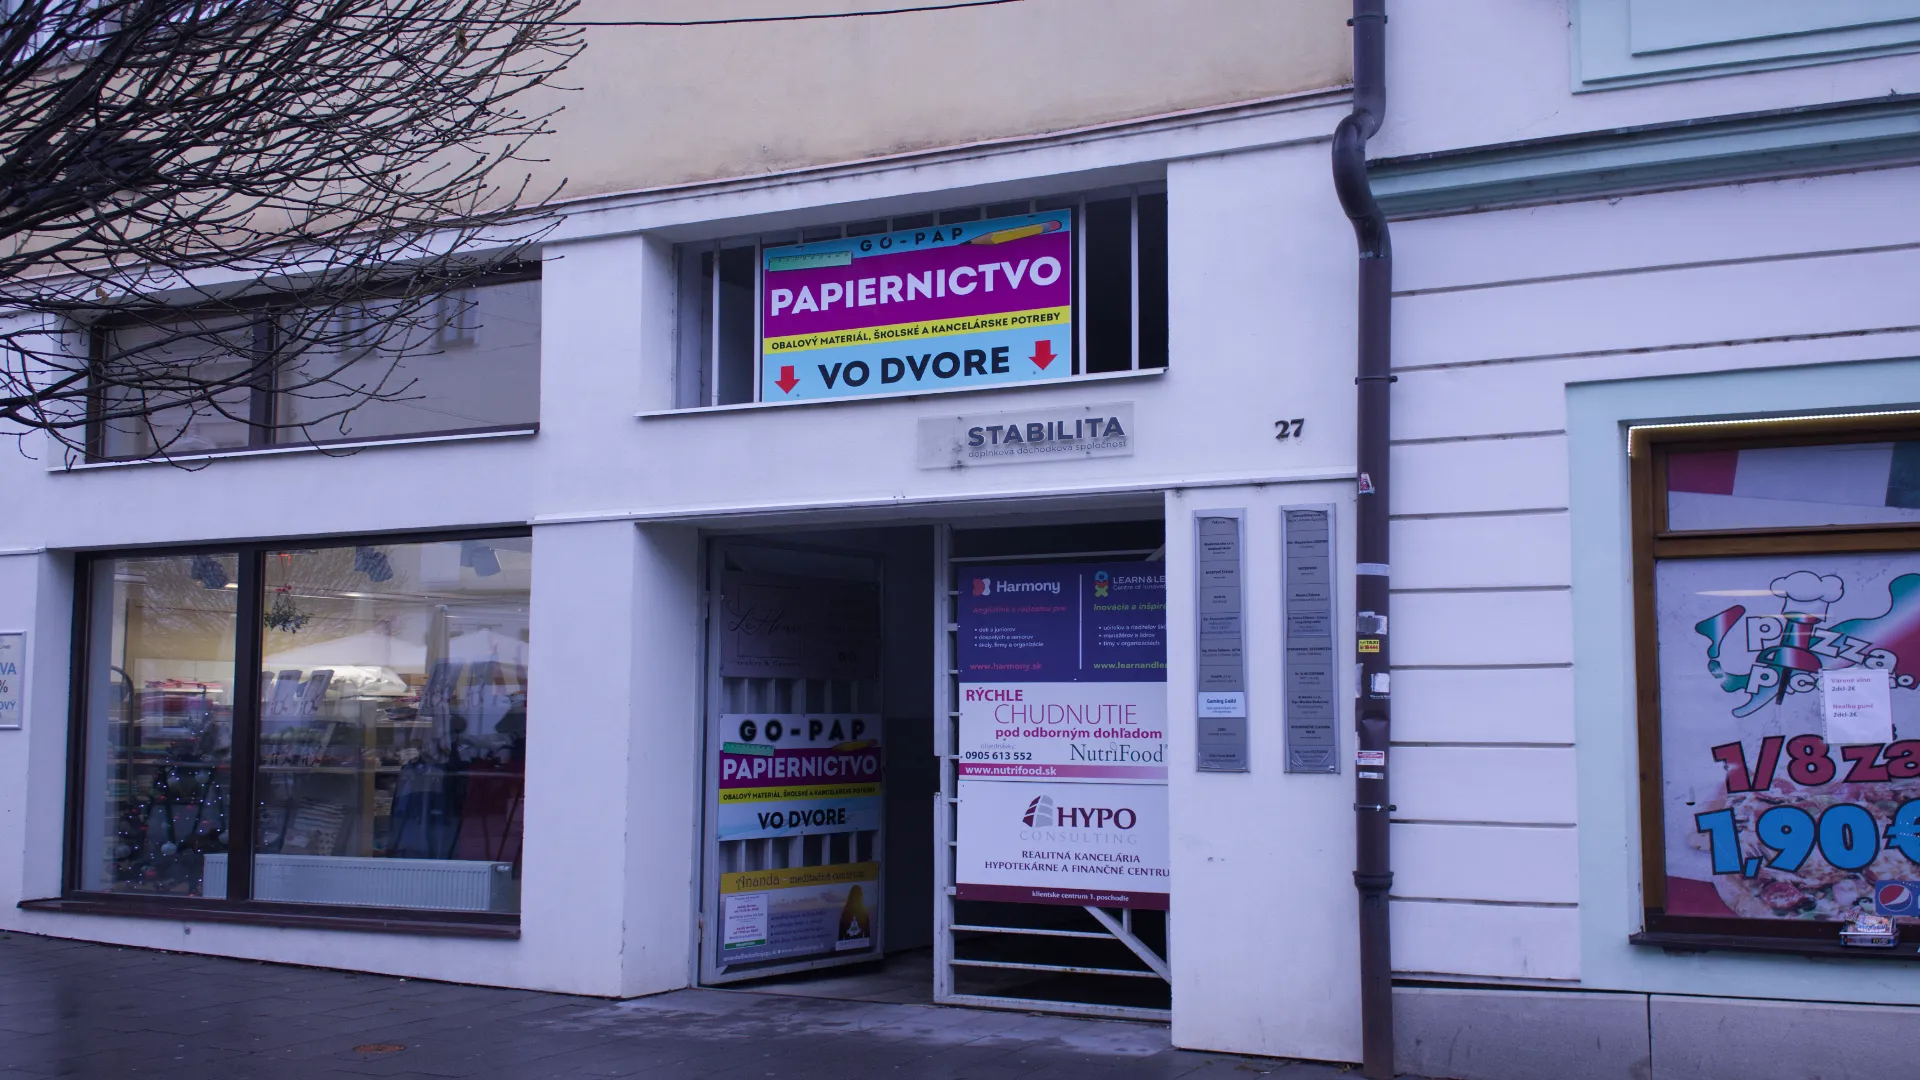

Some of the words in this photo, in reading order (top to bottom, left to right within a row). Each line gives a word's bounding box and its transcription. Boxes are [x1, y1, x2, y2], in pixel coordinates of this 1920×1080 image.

[860, 228, 965, 252] GO-PAP
[771, 256, 1062, 317] PAPIERNICTVO
[771, 336, 818, 350] OBALOVÝ
[820, 331, 872, 346] MATERIÁL,
[873, 324, 919, 340] ŠKOLSKÉ
[921, 326, 930, 335] A
[931, 317, 1009, 333] KANCELÁRSKE
[1011, 311, 1061, 326] POTREBY
[818, 360, 870, 390] VO
[881, 346, 1010, 385] DVORE
[967, 416, 1126, 447] STABILITA
[1275, 418, 1305, 439] 27
[968, 448, 1015, 458] doplnková
[1017, 443, 1073, 455] dôchodková
[996, 580, 1061, 594] Harmony
[1112, 575, 1166, 585] LEARN&LE
[1093, 603, 1129, 612] Inovácia
[970, 662, 1042, 671] www.harmony.sk
[966, 687, 1023, 702] RÝCHLE
[994, 704, 1138, 725] CHUDNUTIE
[739, 719, 866, 742] GO-PAP
[995, 727, 1020, 740] pod
[1023, 727, 1090, 741] odborným
[1093, 727, 1163, 739] dohľadom
[965, 751, 990, 760] 0905
[992, 751, 1011, 761] 613
[1013, 751, 1032, 761] 552
[1070, 743, 1164, 763] NutriFood
[722, 755, 878, 781] PAPIERNICTVO
[965, 766, 1057, 777] www.nutrifood.sk
[723, 791, 752, 801] OBALOVÝ
[753, 791, 783, 799] MATERIÁL,
[783, 789, 808, 797] ŠKOLSKÉ
[757, 812, 784, 830] VO
[788, 807, 846, 829] DVORE
[1057, 806, 1137, 830] HYPO
[1019, 829, 1138, 845] CONSULTING
[1694, 802, 1880, 878] 1,90
[1022, 850, 1071, 861] REALITNÁ
[1074, 851, 1141, 864] KANCELÁRIA
[985, 860, 1059, 873] HYPOTEKÁRNE
[1061, 865, 1069, 873] A
[1072, 864, 1125, 876] FINANČNÉ
[735, 873, 780, 891] Ananda
[1031, 890, 1060, 899] klientske
[1096, 893, 1130, 903] poschodie
